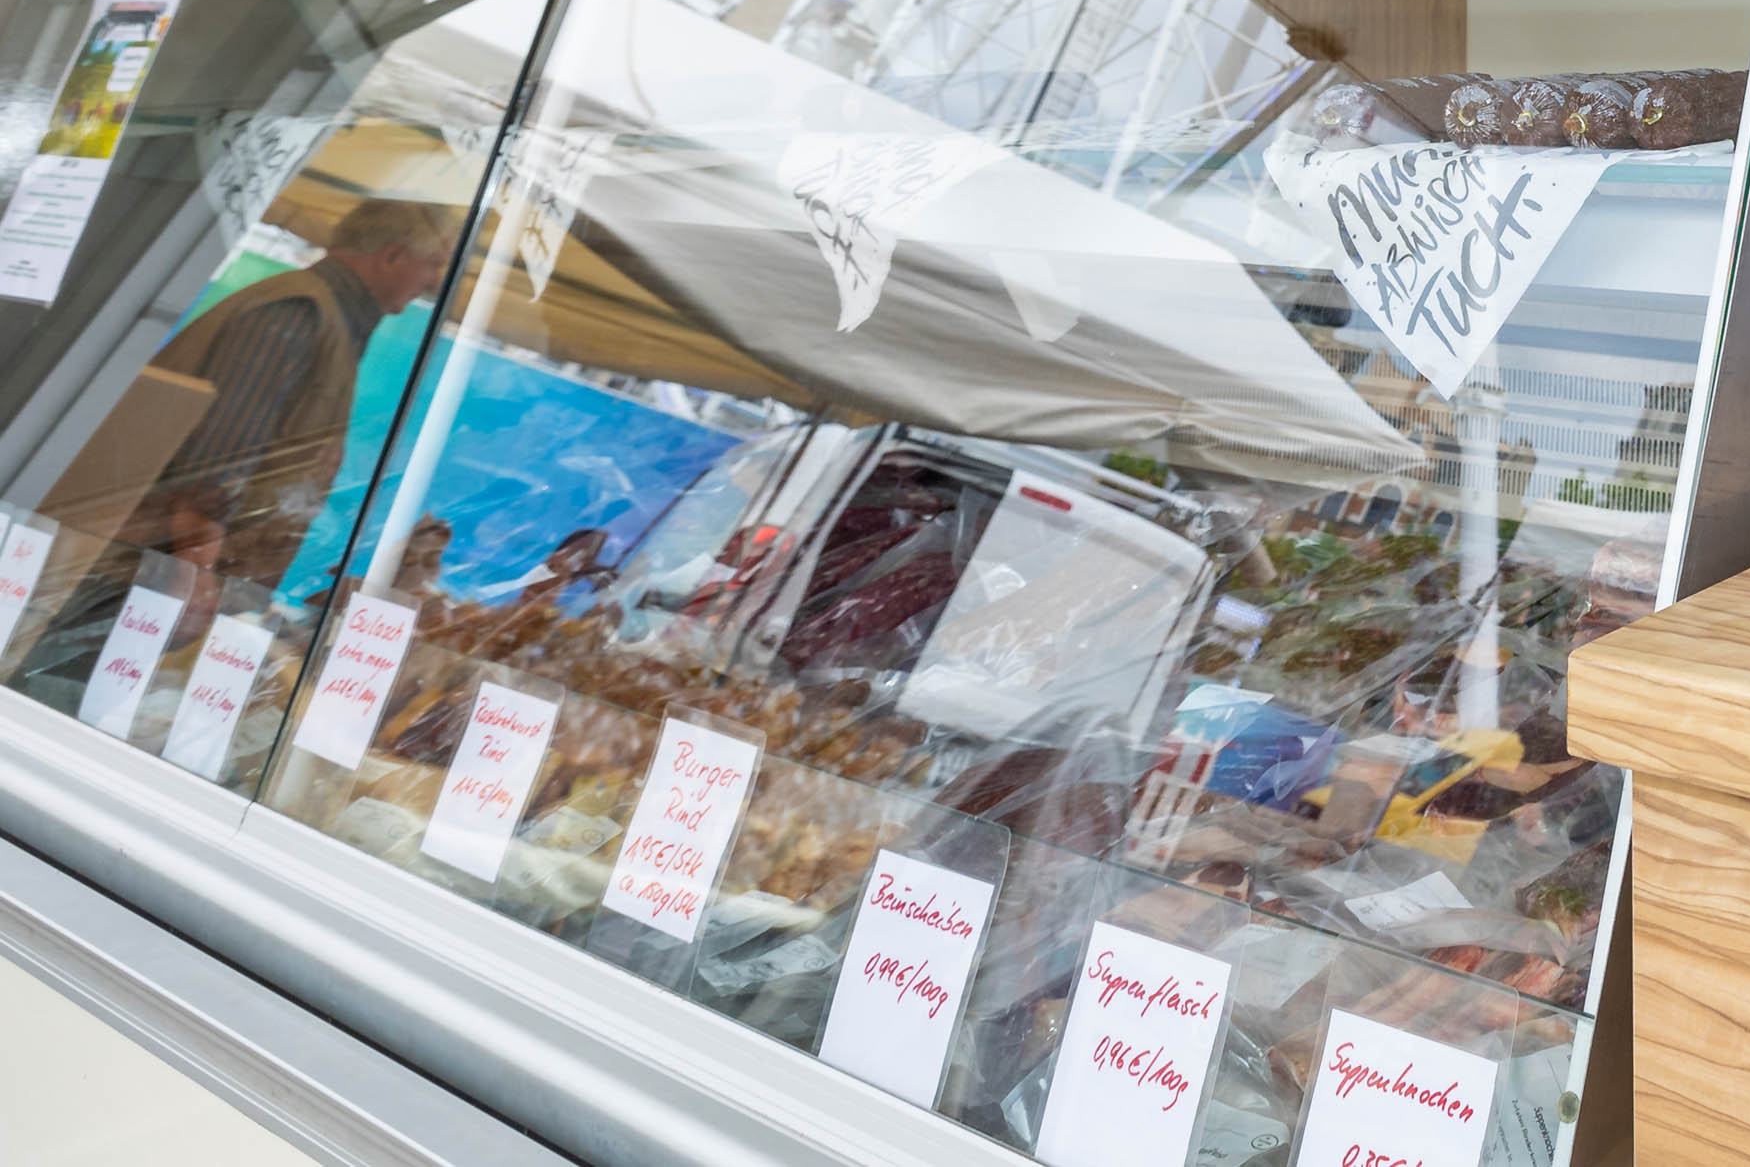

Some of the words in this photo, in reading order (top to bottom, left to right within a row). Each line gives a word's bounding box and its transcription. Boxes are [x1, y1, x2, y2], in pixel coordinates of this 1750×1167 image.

[477, 734, 510, 762] Rind
[673, 740, 742, 802] Burger
[664, 787, 712, 832] Rind
[870, 874, 973, 939] Beinscheiben
[864, 952, 949, 1019] 0,99€/100g
[1087, 950, 1219, 1020] Suppenfleisch
[1093, 1035, 1189, 1112] 0,96€/100g
[1329, 1042, 1474, 1124] Suppenknochen
